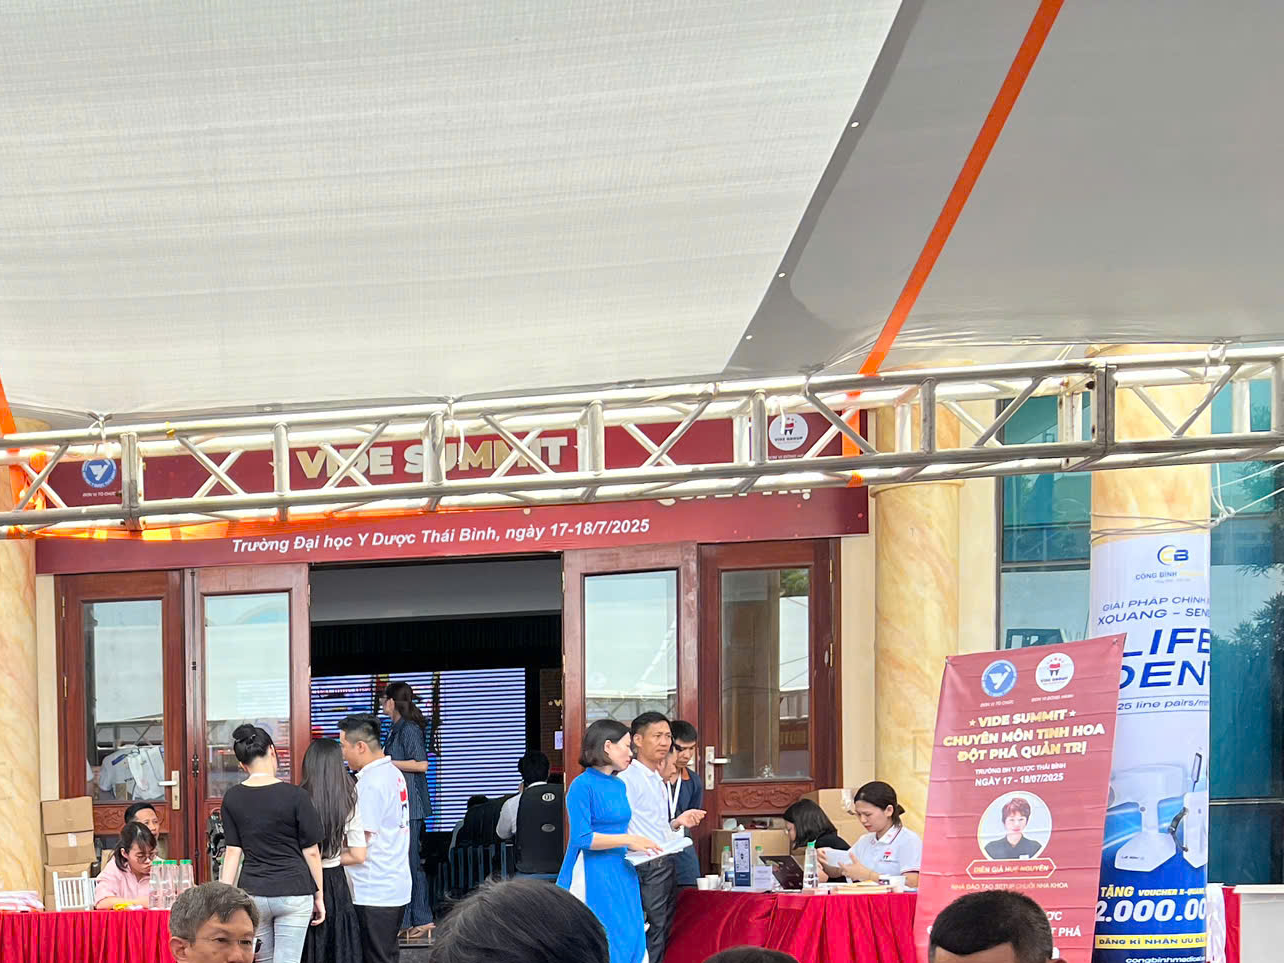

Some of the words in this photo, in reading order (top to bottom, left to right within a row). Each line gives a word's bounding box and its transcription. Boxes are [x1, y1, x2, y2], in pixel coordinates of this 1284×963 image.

[232, 538, 289, 553] Trường
[293, 535, 319, 552] Đại
[324, 534, 353, 551] học
[357, 533, 369, 547] Y
[372, 532, 416, 548] Dược
[421, 529, 455, 544] Thái
[459, 527, 500, 542] Bình,
[505, 524, 545, 542] ngày
[550, 518, 650, 537] 17-18/7/2025
[1135, 571, 1157, 580] CÔNG
[1119, 660, 1211, 690] DEN
[1118, 702, 1132, 710] 25
[1136, 700, 1161, 710] line
[978, 714, 1010, 728] VIDE
[1012, 709, 1068, 725] SUMMIT
[942, 731, 998, 747] CHUYÊN
[1001, 727, 1033, 742] MÔN
[1036, 726, 1069, 740] TINH
[1072, 723, 1105, 737] HOA
[957, 748, 989, 763] ĐỘT
[989, 744, 1018, 760] PHÁ
[1020, 740, 1061, 759] QUẢN
[1063, 740, 1087, 755] TRỊ
[975, 775, 1000, 787] NGÀY
[1002, 776, 1013, 785] 17
[1019, 772, 1064, 784] 18/07/2025
[1101, 883, 1134, 899] TẶNG
[1058, 925, 1082, 937] PHÁ
